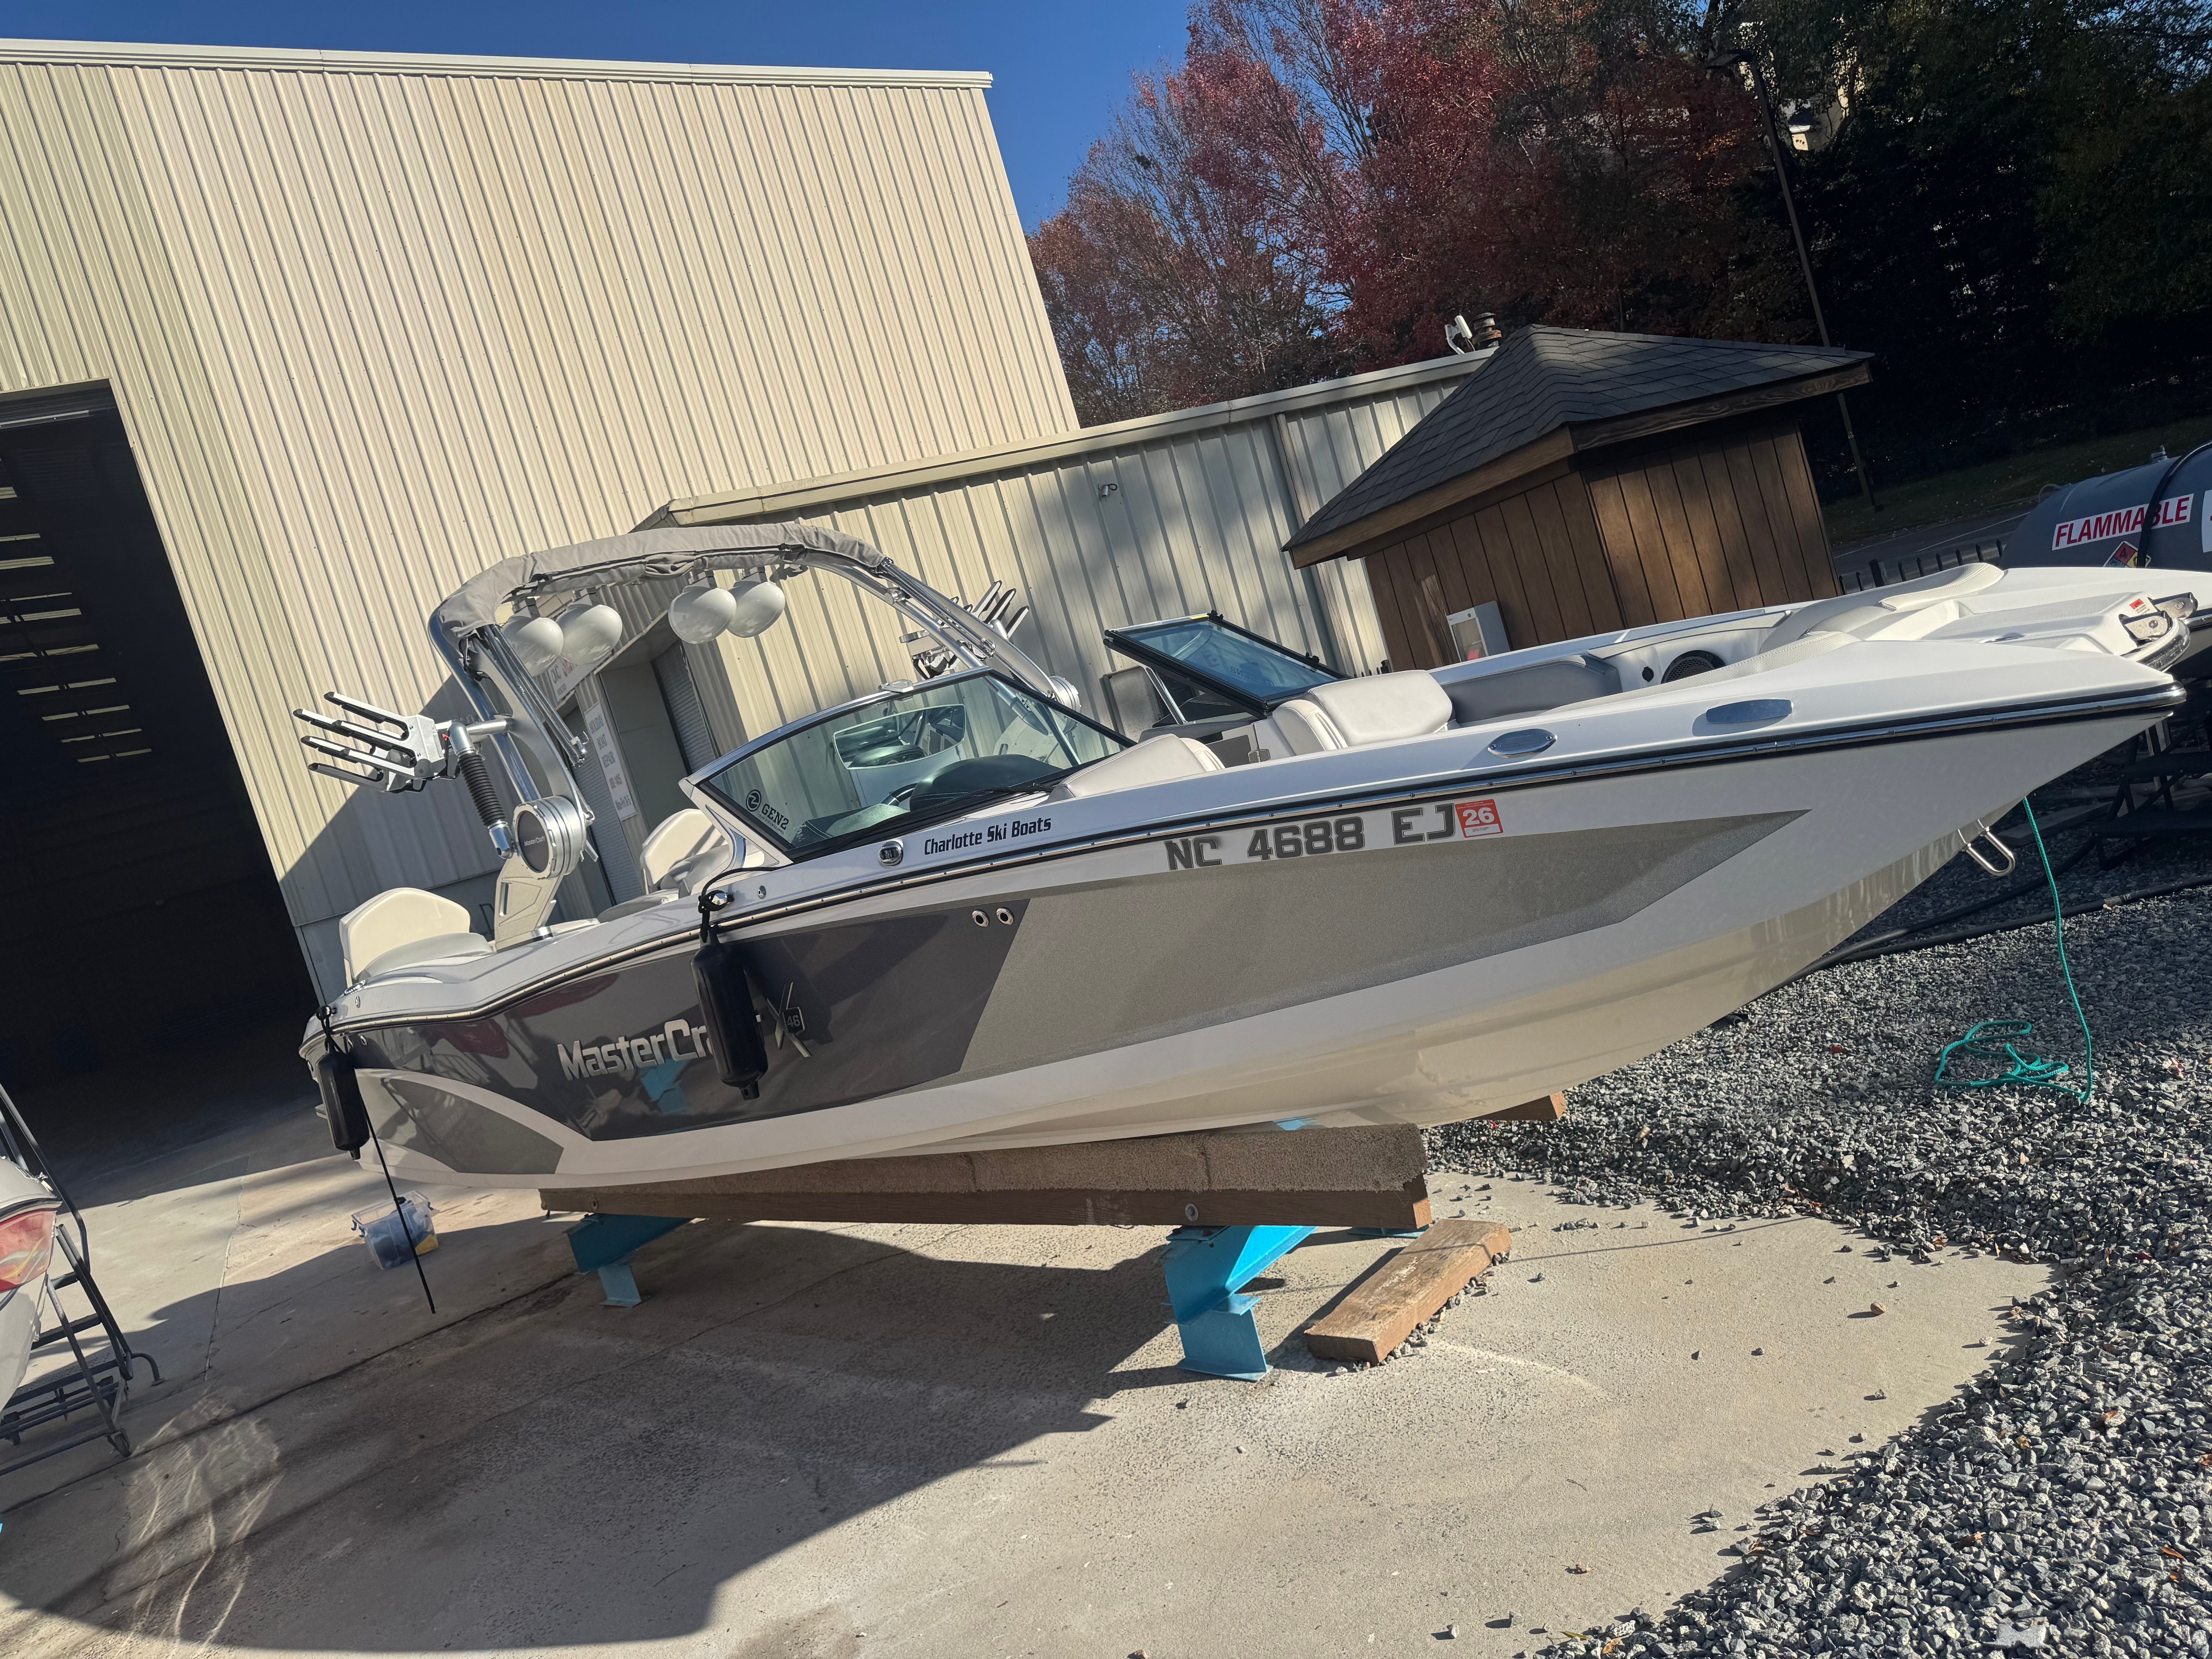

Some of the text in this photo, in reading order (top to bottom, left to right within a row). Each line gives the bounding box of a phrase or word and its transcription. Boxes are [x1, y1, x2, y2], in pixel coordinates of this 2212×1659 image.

[761, 803, 789, 830] GEN2
[1463, 807, 1495, 826] 26
[924, 817, 1051, 855] Charlotte Ski Boats
[1163, 803, 1456, 871] NC 4688 EJ
[787, 1015, 801, 1027] 46
[557, 1019, 713, 1080] MasterCr
